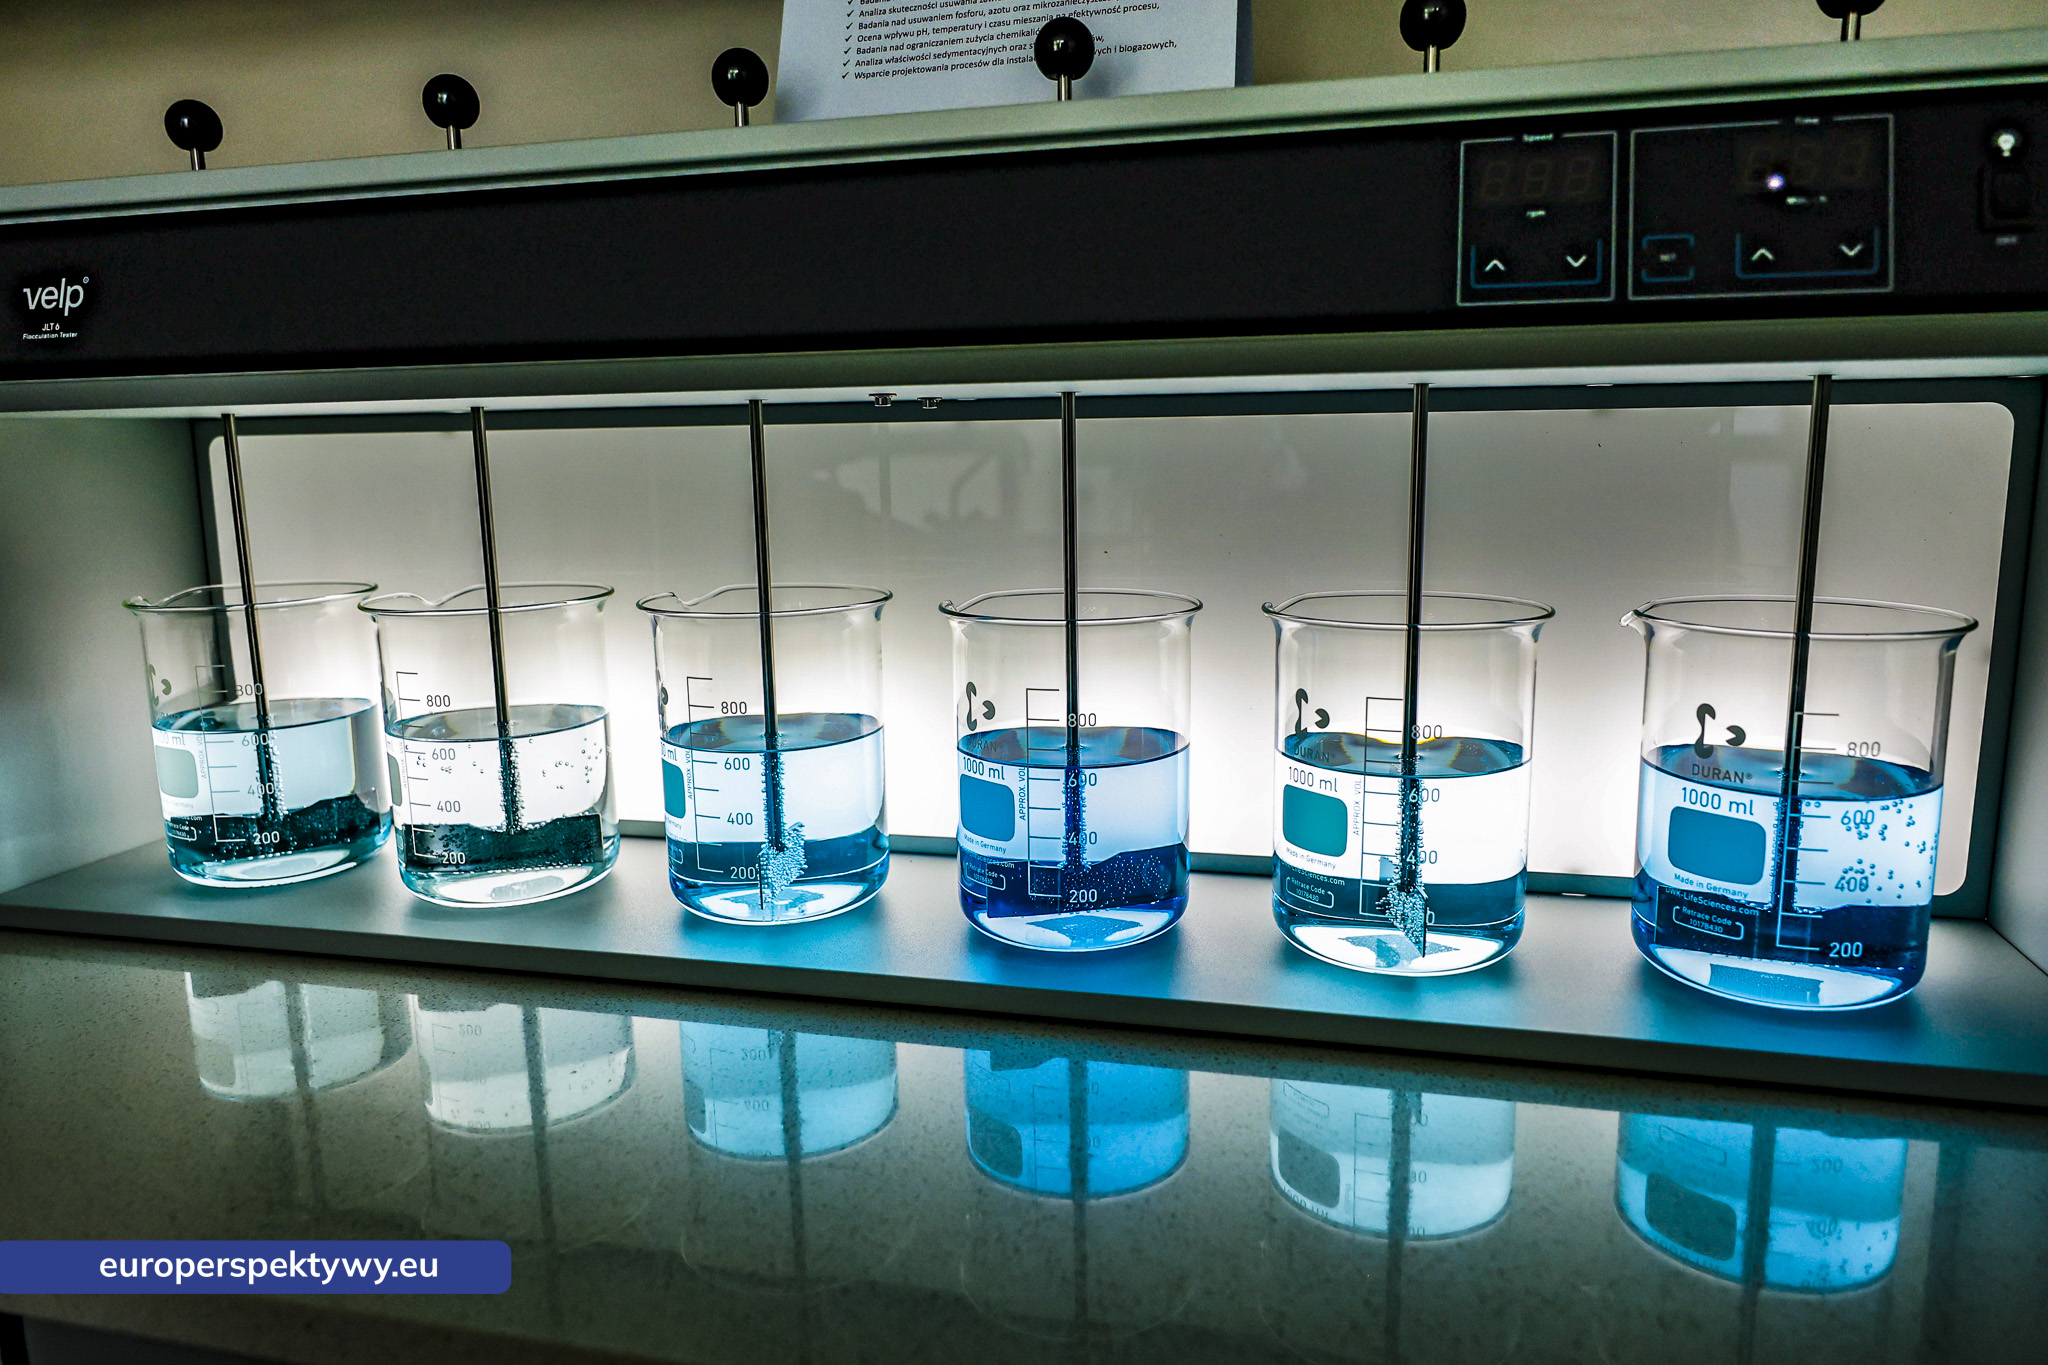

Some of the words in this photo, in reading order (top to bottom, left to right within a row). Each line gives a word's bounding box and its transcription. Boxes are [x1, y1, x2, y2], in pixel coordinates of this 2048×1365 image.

[858, 19, 890, 30] Badania
[891, 17, 907, 27] nad
[908, 14, 953, 25] usuwaniem
[955, 10, 986, 20] fosforu,
[988, 6, 1011, 16] azotu
[859, 8, 887, 18] Analiza
[888, 2, 938, 15] skuteczności
[857, 34, 882, 43] Ocena
[884, 30, 915, 40] wpływu
[916, 28, 930, 37] pH,
[932, 22, 983, 35] temperatury
[988, 19, 1011, 28] czasu
[1012, 14, 1054, 25] mieszania
[1068, 5, 1121, 18] efektywność
[1122, 3, 1160, 14] procesu,
[856, 45, 888, 55] Badania
[889, 42, 905, 51] nad
[906, 38, 964, 51] ograniczaniem
[965, 33, 995, 44] zużycia
[996, 28, 1040, 40] chemikalió
[854, 69, 890, 80] Wsparcie
[891, 63, 949, 77] projektowania
[950, 60, 991, 72] procesów
[991, 57, 1005, 66] dla
[1119, 39, 1177, 53] biogazowych,
[855, 58, 883, 67] Analiza
[884, 52, 932, 64] właściwości
[933, 44, 1008, 60] sedymentacyjnych
[1009, 42, 1027, 51] oraz
[23, 277, 84, 317] velp
[41, 322, 55, 331] JLT
[236, 682, 264, 697] 800
[426, 694, 451, 708] 800
[720, 701, 748, 715] 800
[1067, 712, 1097, 728] 800
[241, 732, 270, 747] 600
[1411, 724, 1443, 740] 800
[431, 747, 456, 761] 600
[1846, 741, 1881, 758] 800
[724, 757, 751, 771] 600
[963, 756, 985, 776] 1000
[988, 765, 1006, 781] ml
[1068, 772, 1098, 787] 600
[1288, 766, 1314, 788] 1000
[1319, 777, 1338, 793] ml
[247, 781, 275, 796] 400
[1408, 787, 1441, 803] 600
[436, 800, 461, 813] 400
[1681, 786, 1722, 810] 1000
[1728, 796, 1755, 816] ml
[726, 812, 754, 826] 400
[1841, 809, 1875, 827] 600
[252, 831, 280, 846] 200
[1068, 831, 1098, 845] 400
[980, 840, 1007, 855] Germany
[442, 852, 466, 865] 200
[1305, 854, 1337, 871] Germany
[1406, 849, 1438, 865] 400
[730, 866, 756, 880] 200
[1674, 872, 1694, 886] Made
[1695, 880, 1705, 889] in
[1706, 882, 1749, 899] Germany
[1834, 876, 1870, 893] 400
[1069, 888, 1098, 904] 200
[1681, 905, 1711, 921] Retrace
[1711, 914, 1733, 926] Code
[1689, 918, 1724, 934] 10178430
[1828, 941, 1864, 959] 200
